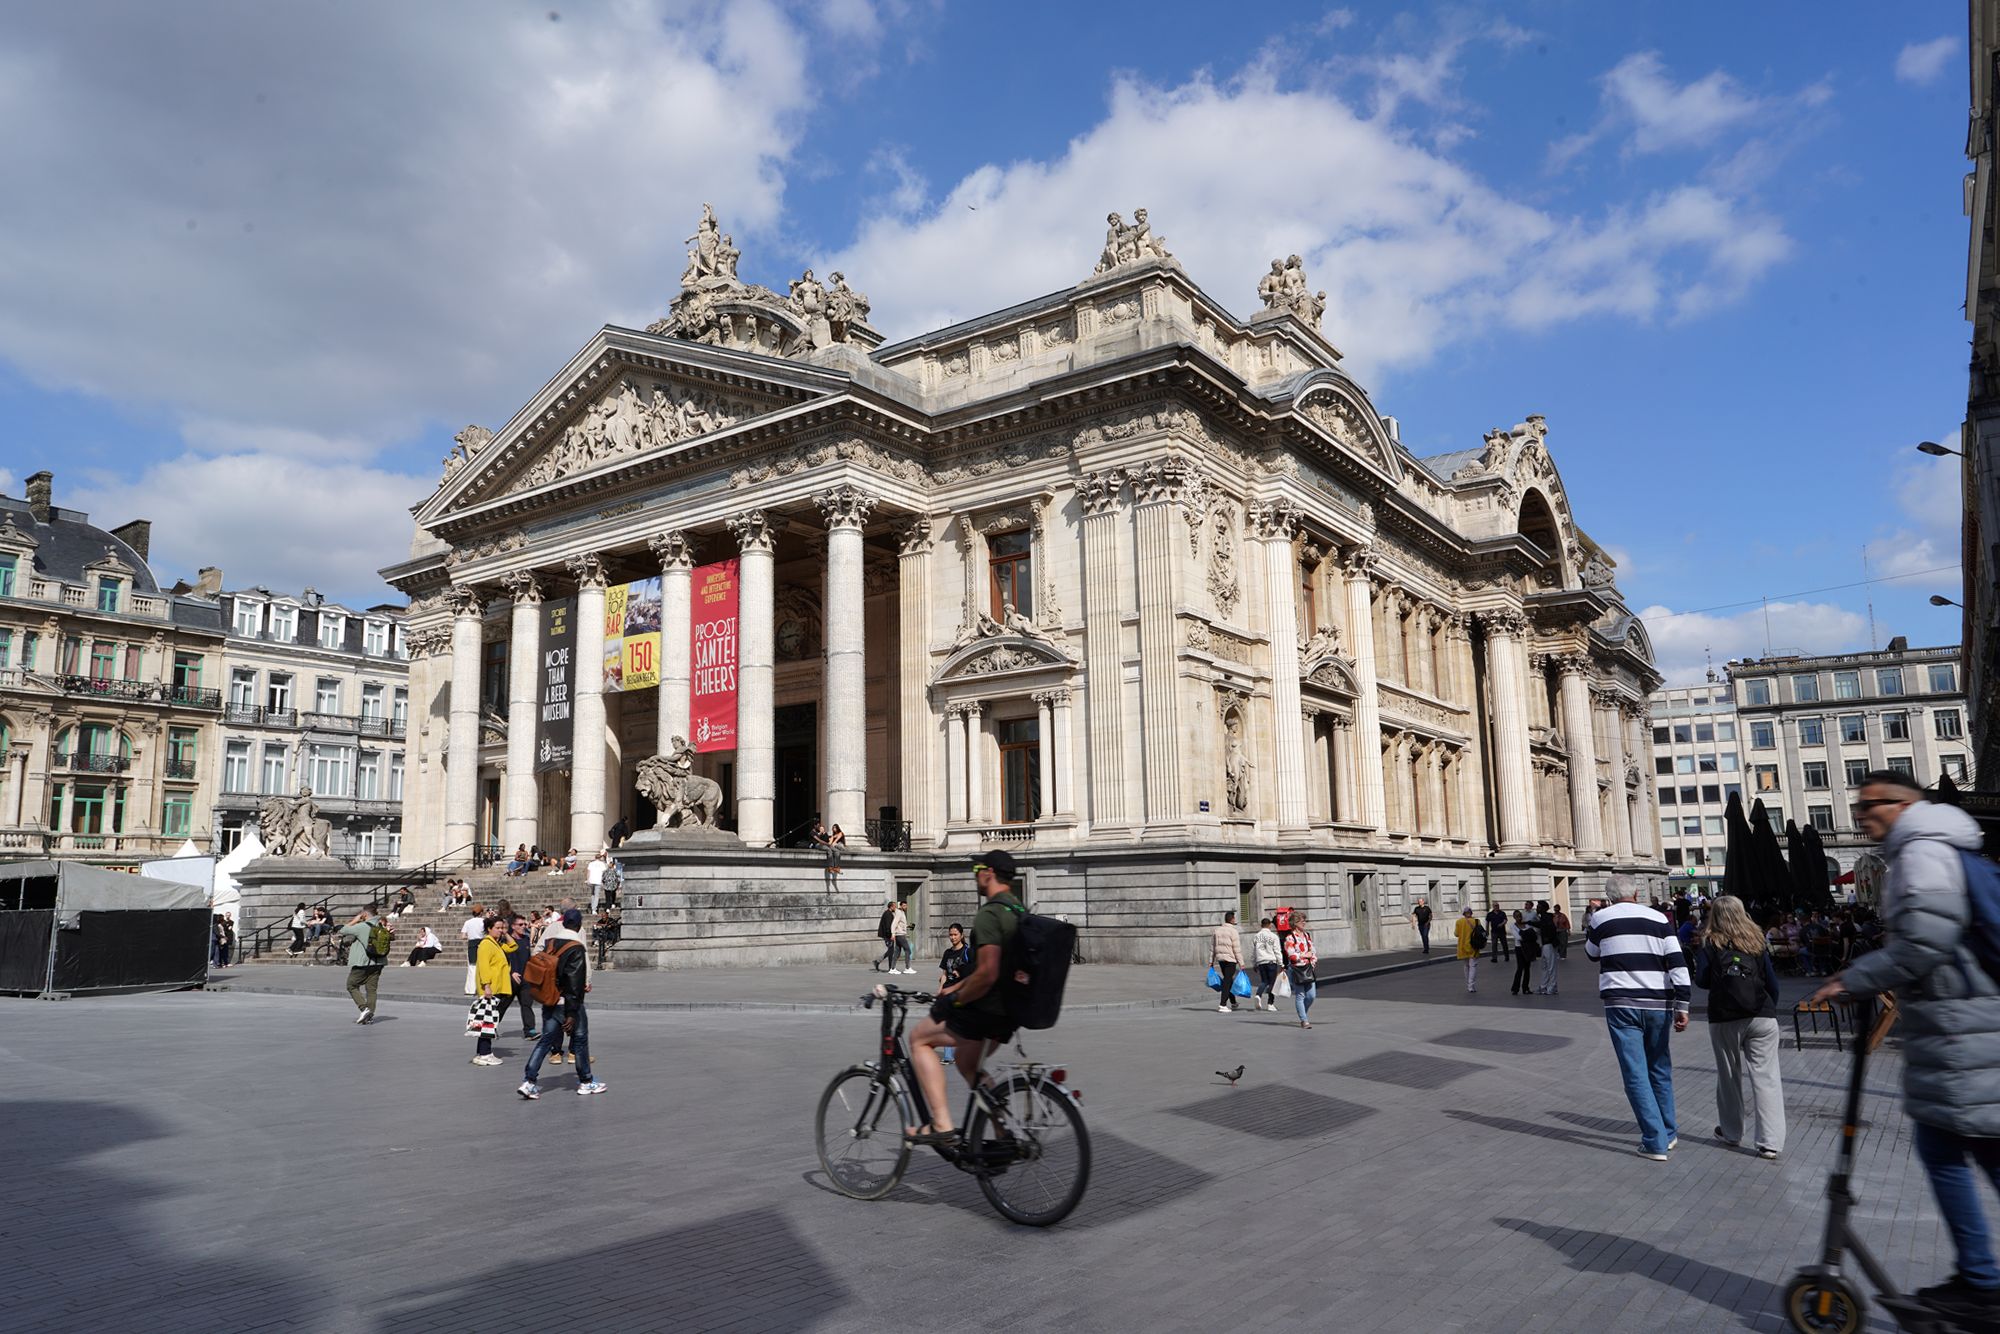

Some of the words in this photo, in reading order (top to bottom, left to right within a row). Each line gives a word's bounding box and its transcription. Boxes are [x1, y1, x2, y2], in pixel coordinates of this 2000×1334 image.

[608, 600, 623, 614] TOP
[704, 592, 726, 604] EXPERIENCE
[606, 612, 622, 636] BAR
[695, 617, 736, 641] PROOST
[545, 648, 569, 668] MORE
[629, 640, 652, 673] 150
[695, 633, 736, 668] SANTÉ!
[548, 666, 565, 685] THAN
[642, 671, 656, 682] BEERS
[695, 665, 736, 696] CHEERS
[545, 687, 550, 703] A
[550, 684, 568, 703] BEER
[542, 702, 570, 722] MUSEUM
